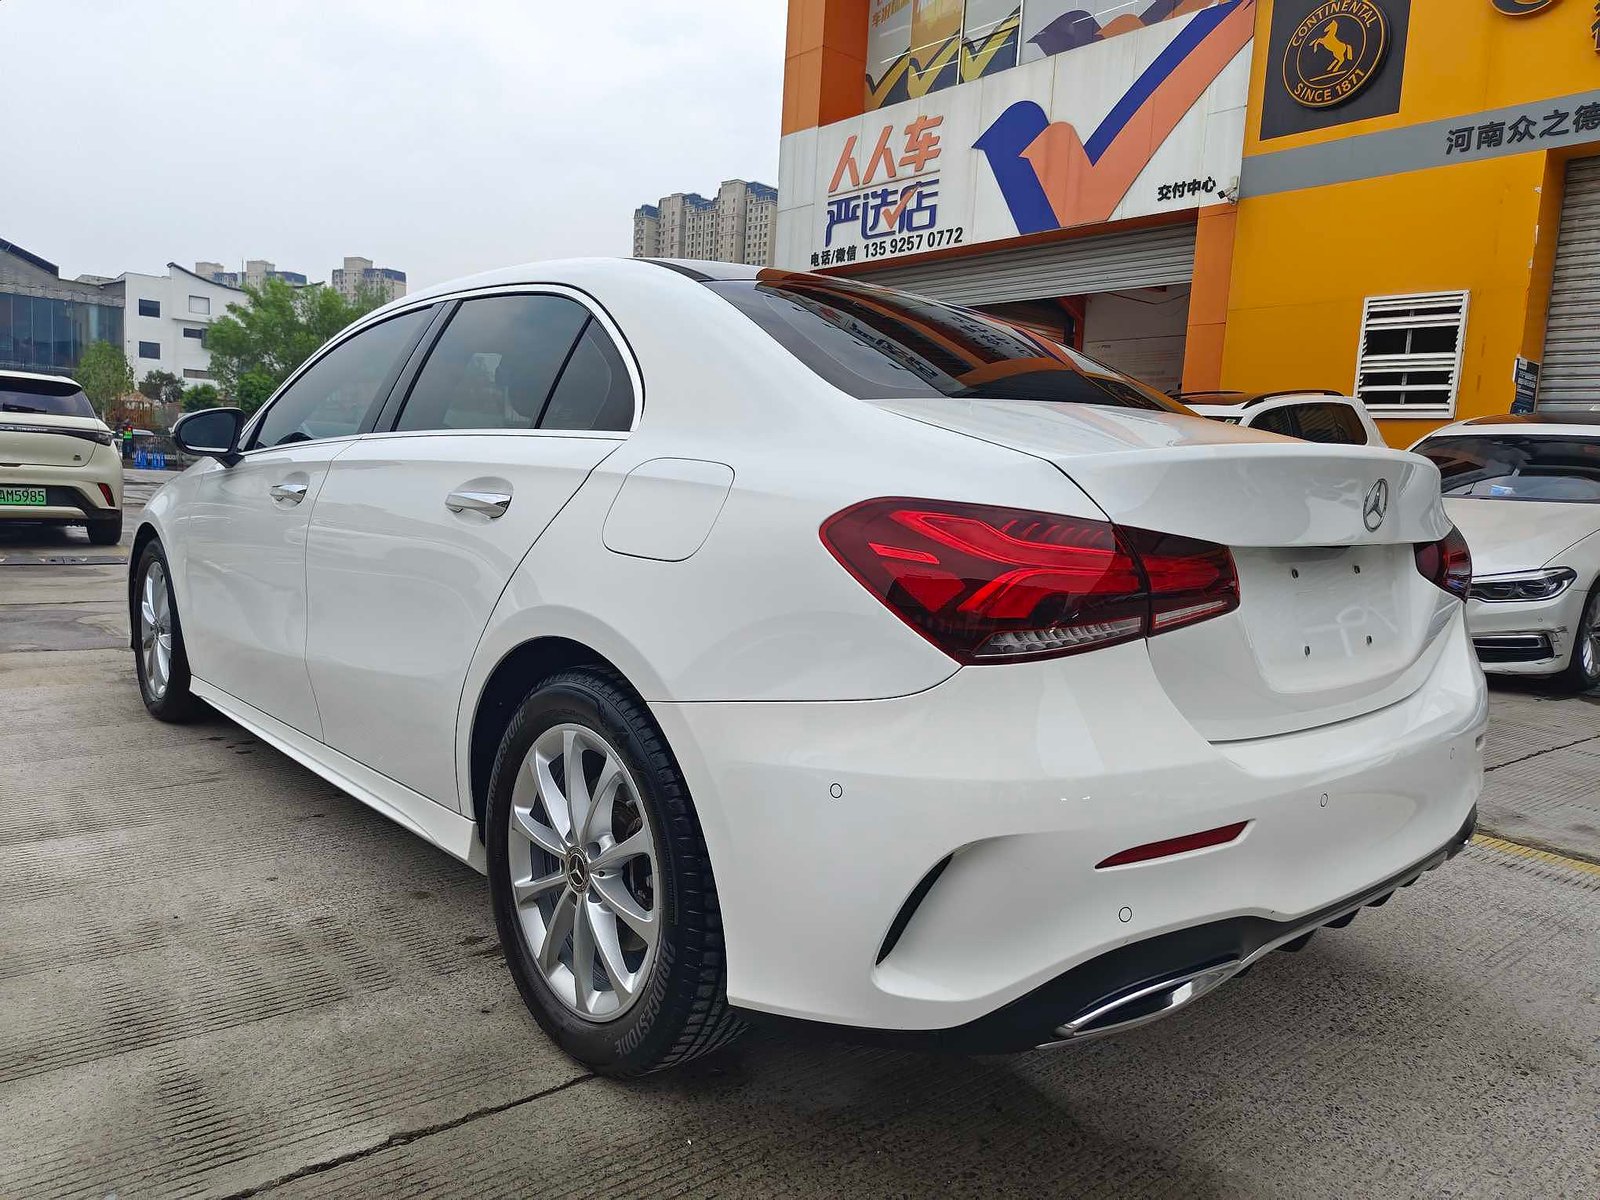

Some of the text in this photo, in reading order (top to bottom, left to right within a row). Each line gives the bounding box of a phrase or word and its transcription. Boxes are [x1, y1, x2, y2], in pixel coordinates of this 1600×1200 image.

[1291, 0, 1378, 47] CONTINENTAL
[1294, 68, 1366, 103] SINCE 1871
[1445, 101, 1600, 155] 河南众之德
[828, 114, 944, 193] 人人车
[1157, 176, 1217, 202] 交付中心
[825, 178, 940, 248] 严选店
[810, 226, 964, 267] 电话/微信 135 9257 0772
